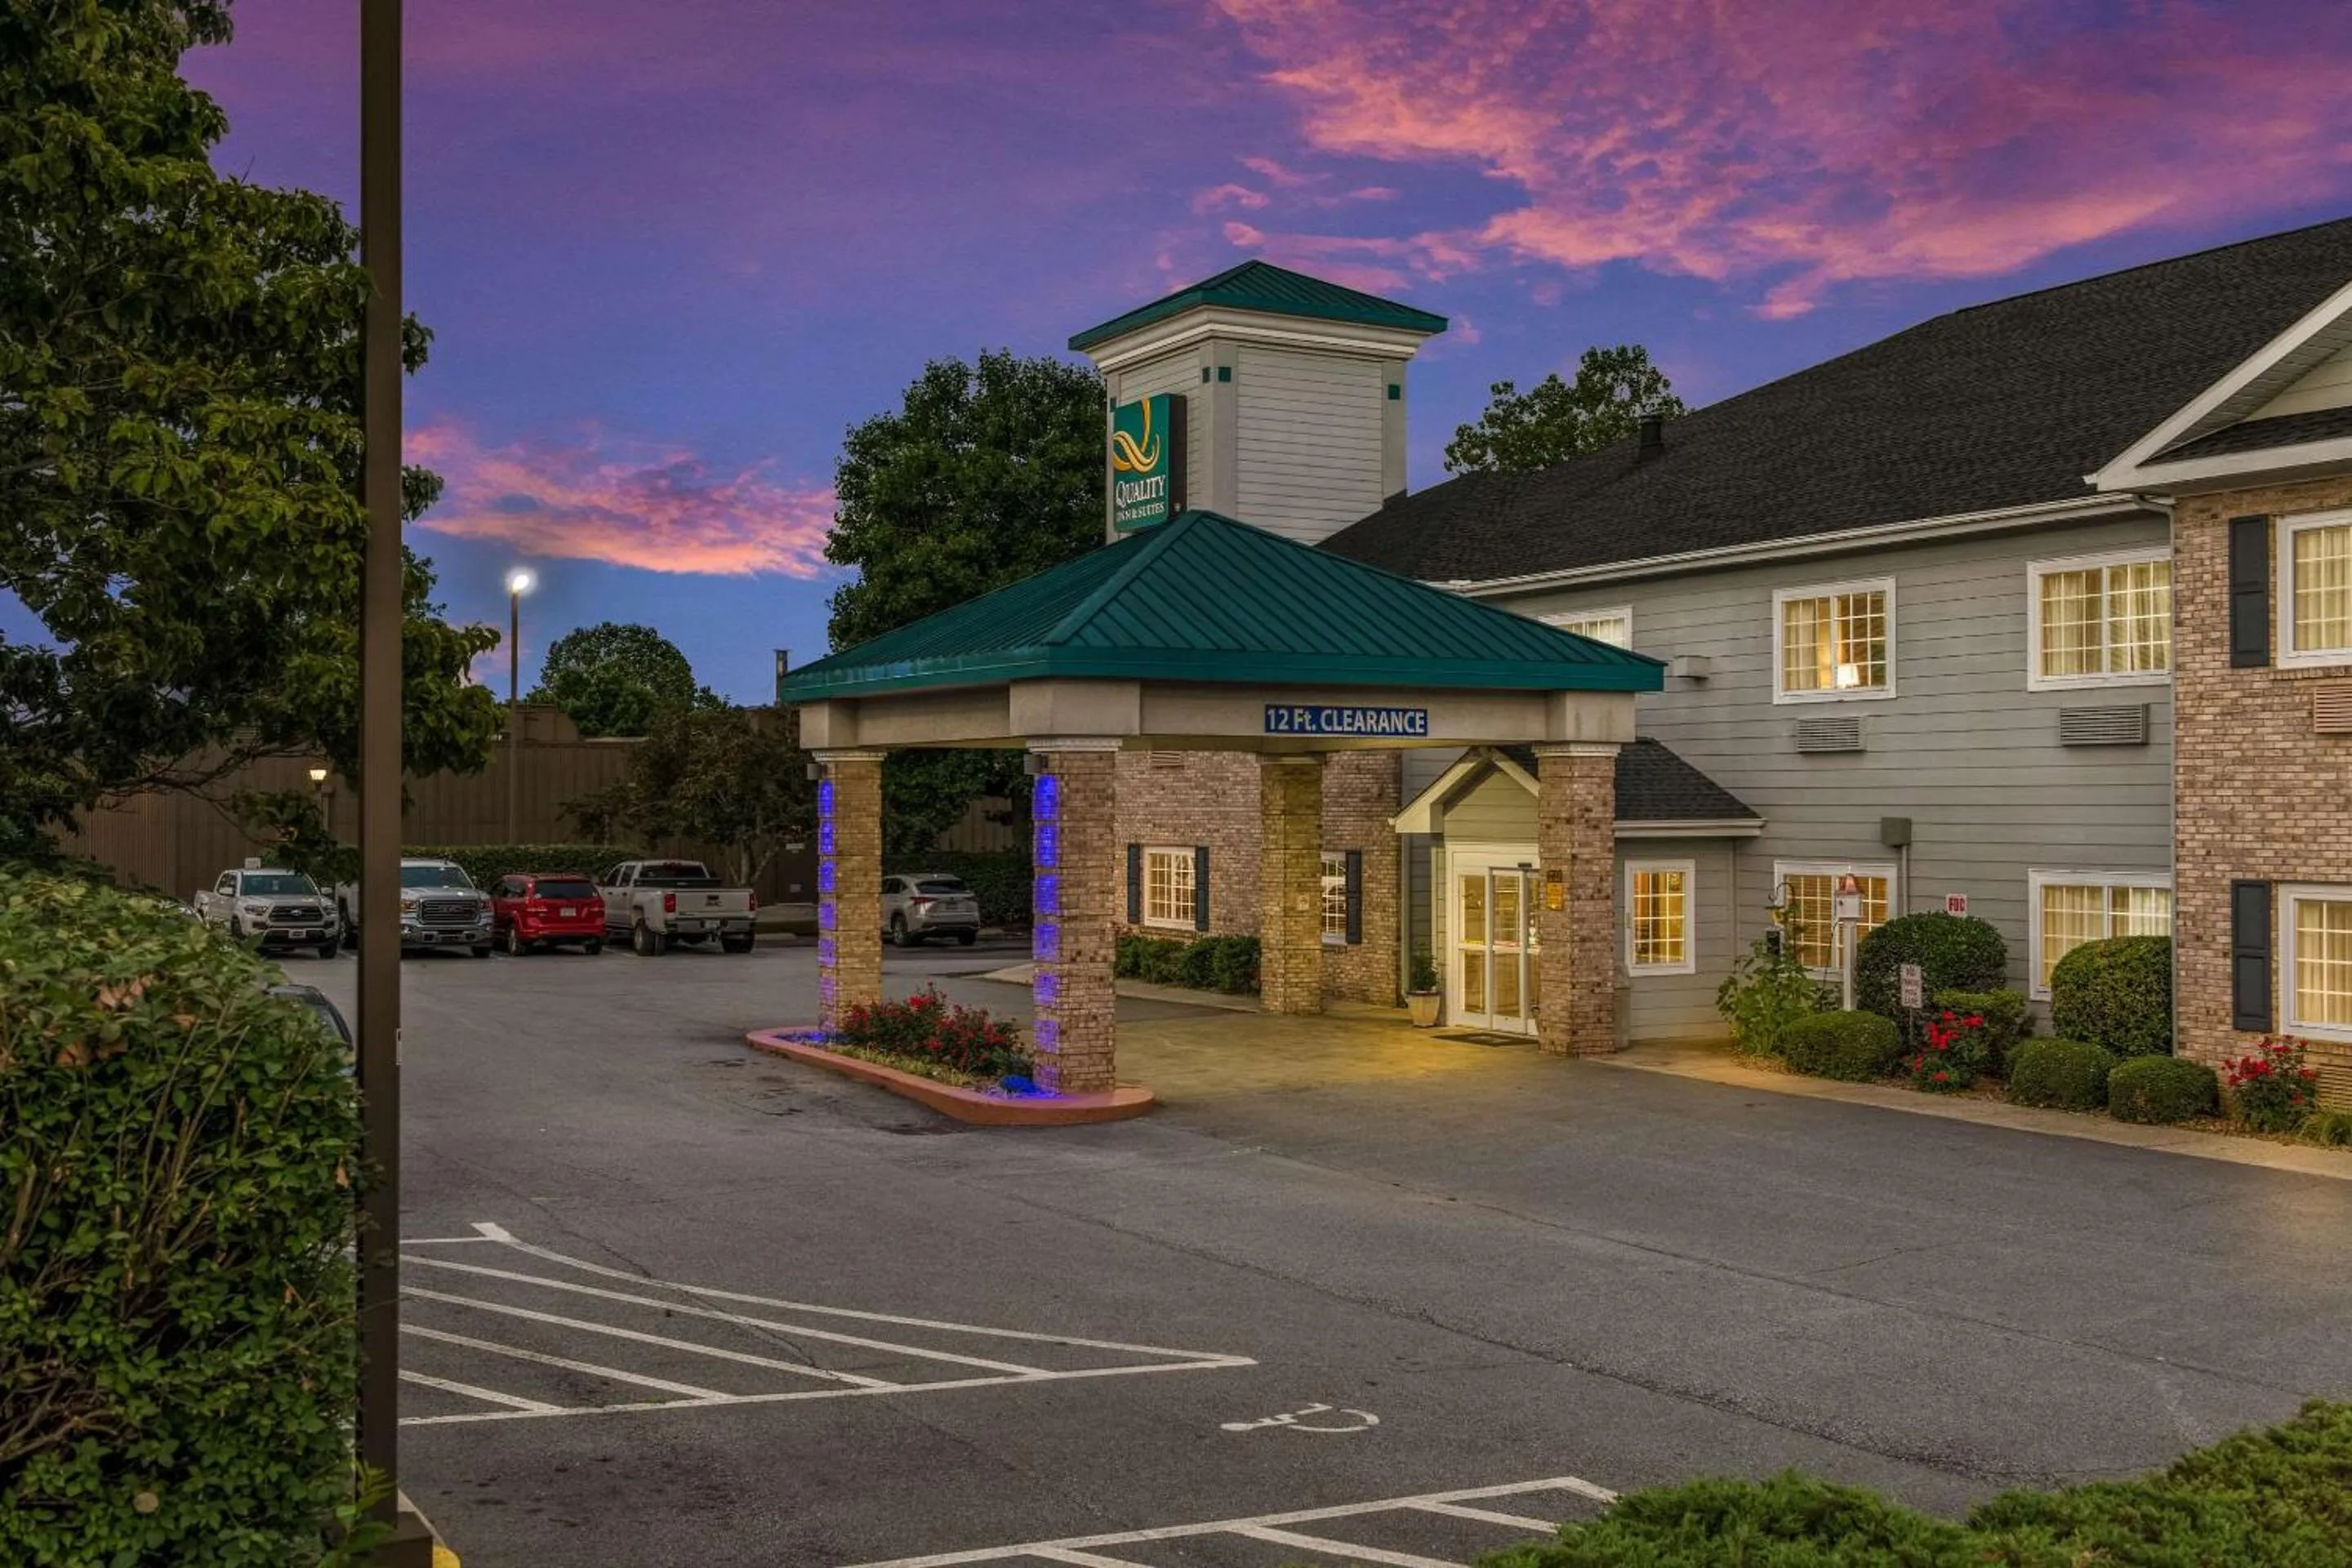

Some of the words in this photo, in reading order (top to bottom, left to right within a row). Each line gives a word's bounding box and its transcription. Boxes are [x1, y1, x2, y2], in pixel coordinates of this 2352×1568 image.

[1116, 474, 1165, 508] QUALITY
[1267, 708, 1289, 730] 12
[1294, 709, 1316, 731] Ft.
[1320, 710, 1425, 733] CLEARANCE
